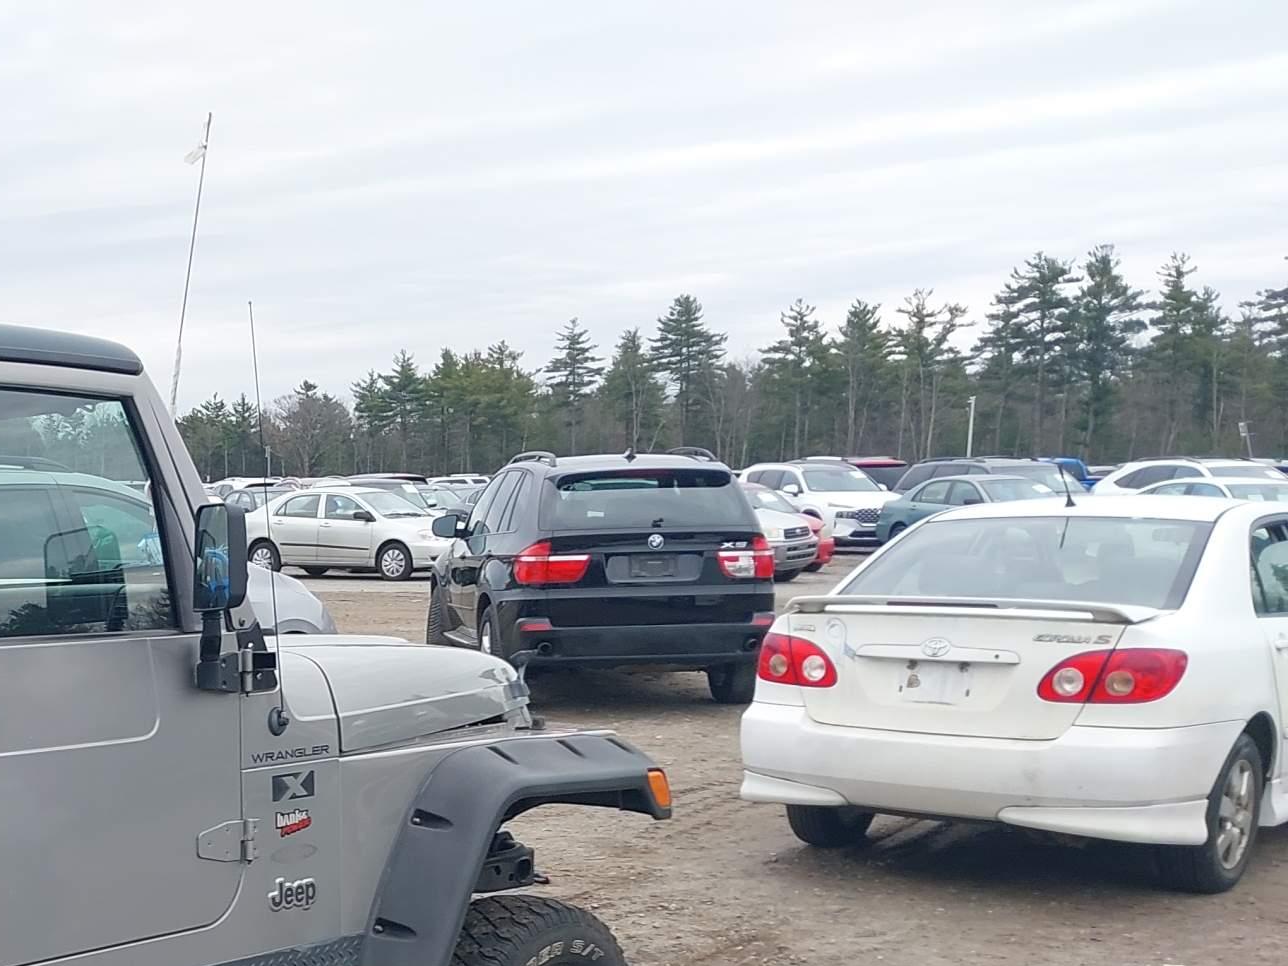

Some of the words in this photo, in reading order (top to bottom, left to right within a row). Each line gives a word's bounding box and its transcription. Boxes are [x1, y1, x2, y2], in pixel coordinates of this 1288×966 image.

[251, 744, 330, 764] WRANGLER
[277, 770, 314, 802] X
[267, 876, 317, 913] Jeep
[570, 939, 606, 961] S/T
